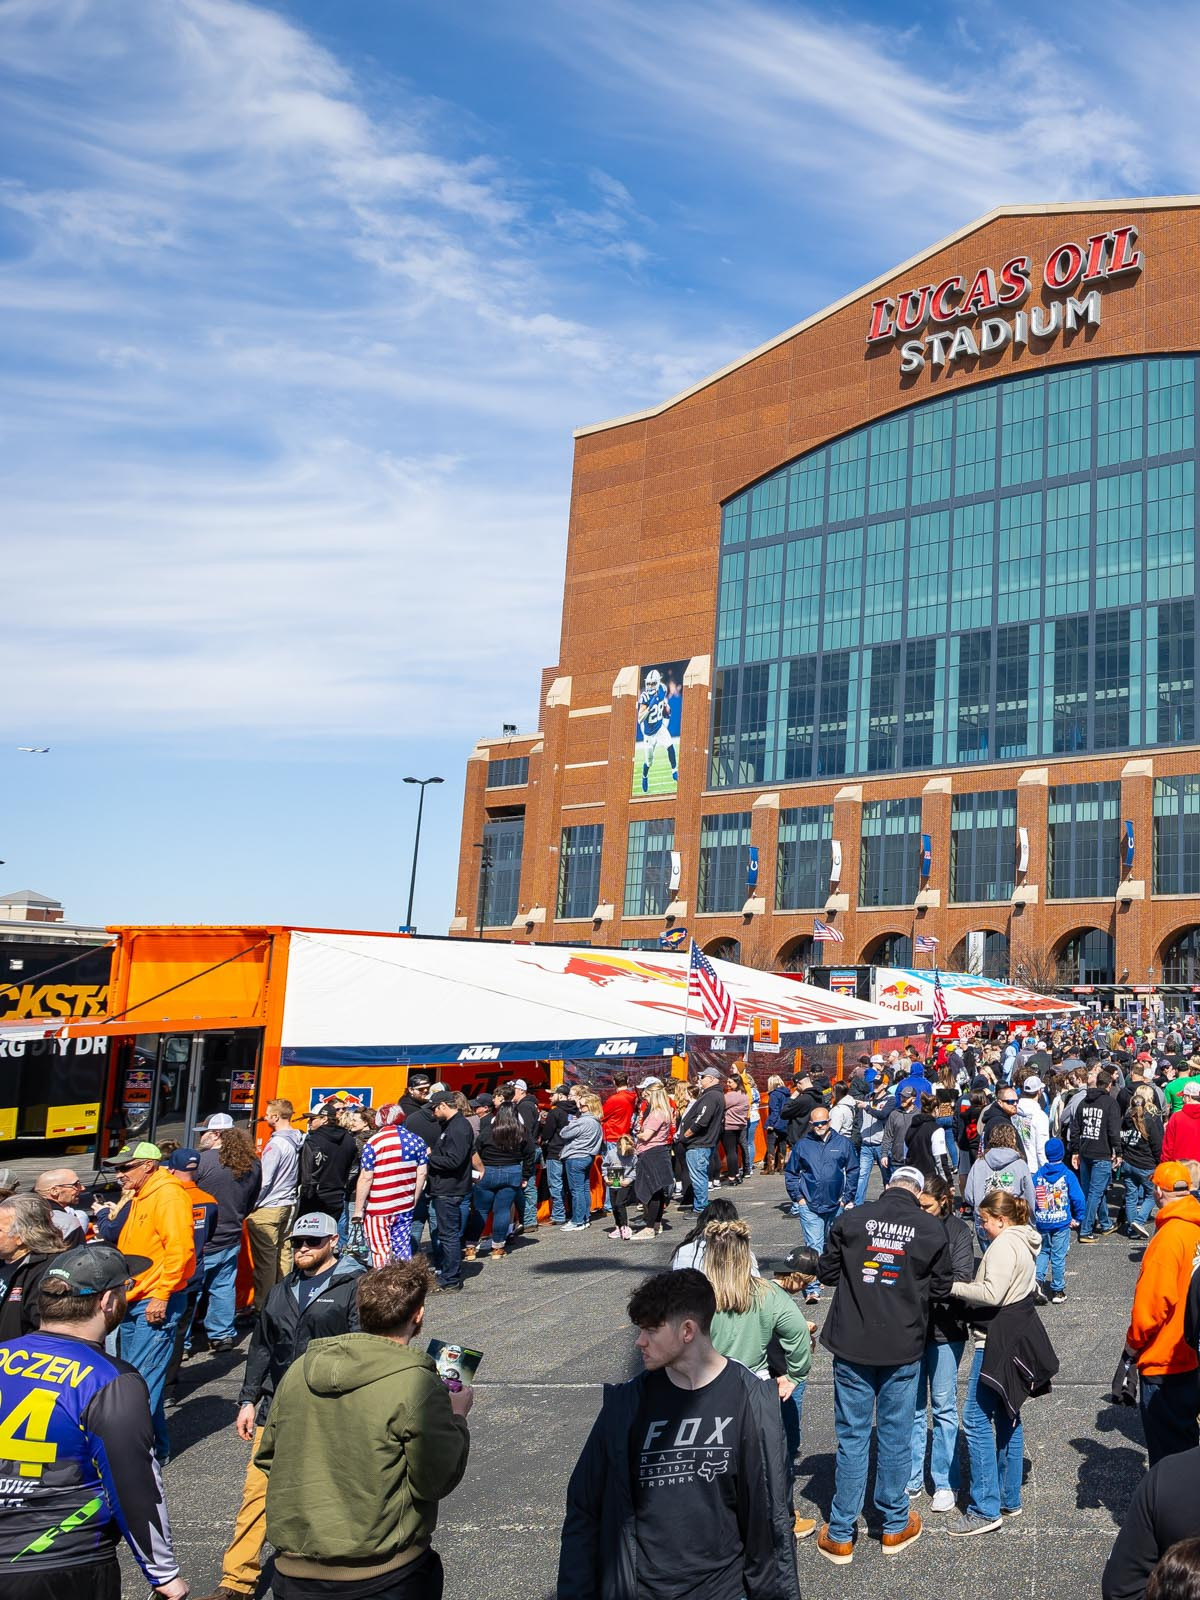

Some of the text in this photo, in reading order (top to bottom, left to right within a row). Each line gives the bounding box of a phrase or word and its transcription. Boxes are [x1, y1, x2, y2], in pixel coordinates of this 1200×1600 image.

[865, 224, 1145, 345] LUCAS OIL
[899, 290, 1101, 374] STADIUM
[648, 703, 664, 724] 28
[902, 1000, 923, 1012] Bull
[457, 1045, 500, 1060] KTM
[595, 1040, 638, 1056] KTM
[1083, 1107, 1103, 1119] MOTO
[868, 1231, 912, 1242] RACING
[878, 1221, 916, 1238] YAMAHA
[871, 1237, 904, 1251] YAMALUBE
[642, 1416, 733, 1450] FOX
[641, 1450, 730, 1463] RACING
[640, 1463, 694, 1476] EST.1974
[640, 1475, 693, 1488] TRDMRK
